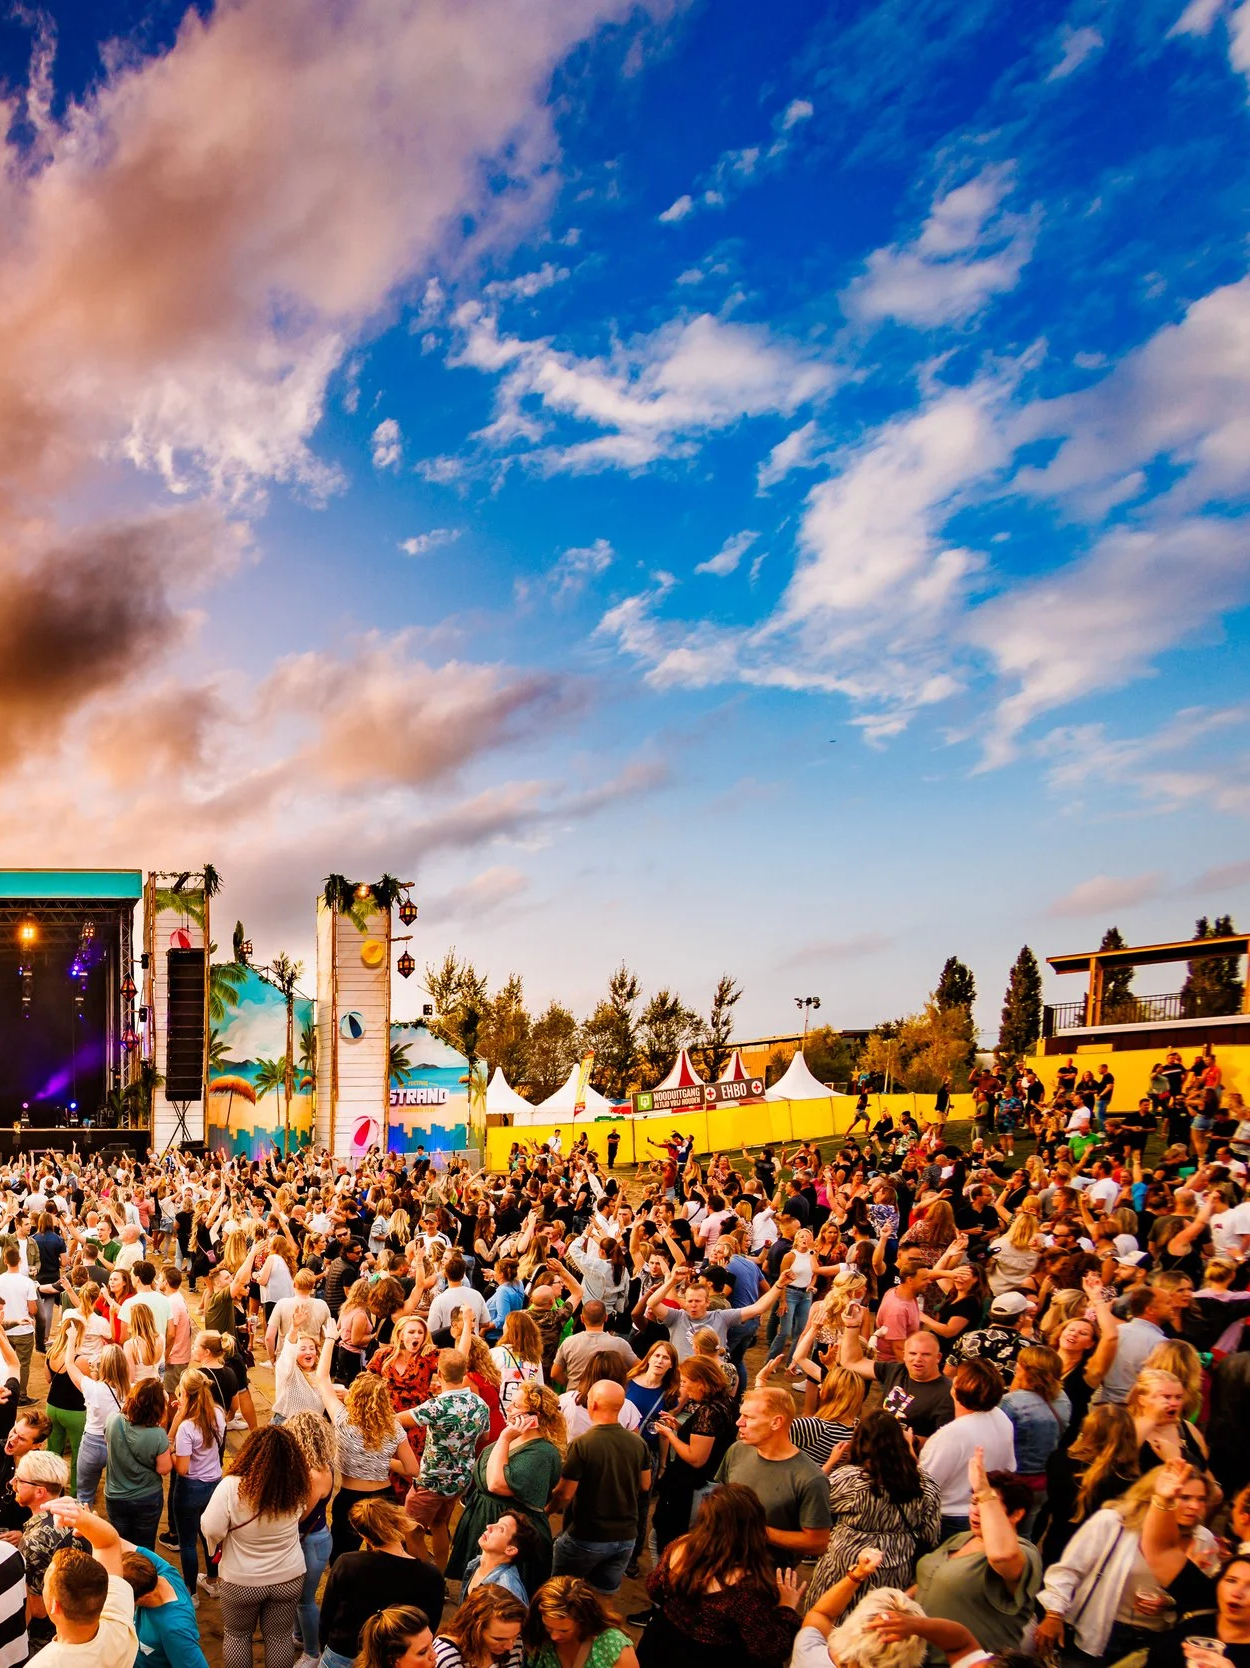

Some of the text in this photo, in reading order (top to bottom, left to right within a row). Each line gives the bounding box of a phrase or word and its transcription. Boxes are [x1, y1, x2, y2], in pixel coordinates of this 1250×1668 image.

[390, 1088, 449, 1104] STRAND
[653, 1087, 700, 1102] NOODUITGANG
[721, 1082, 747, 1099] EHBO
